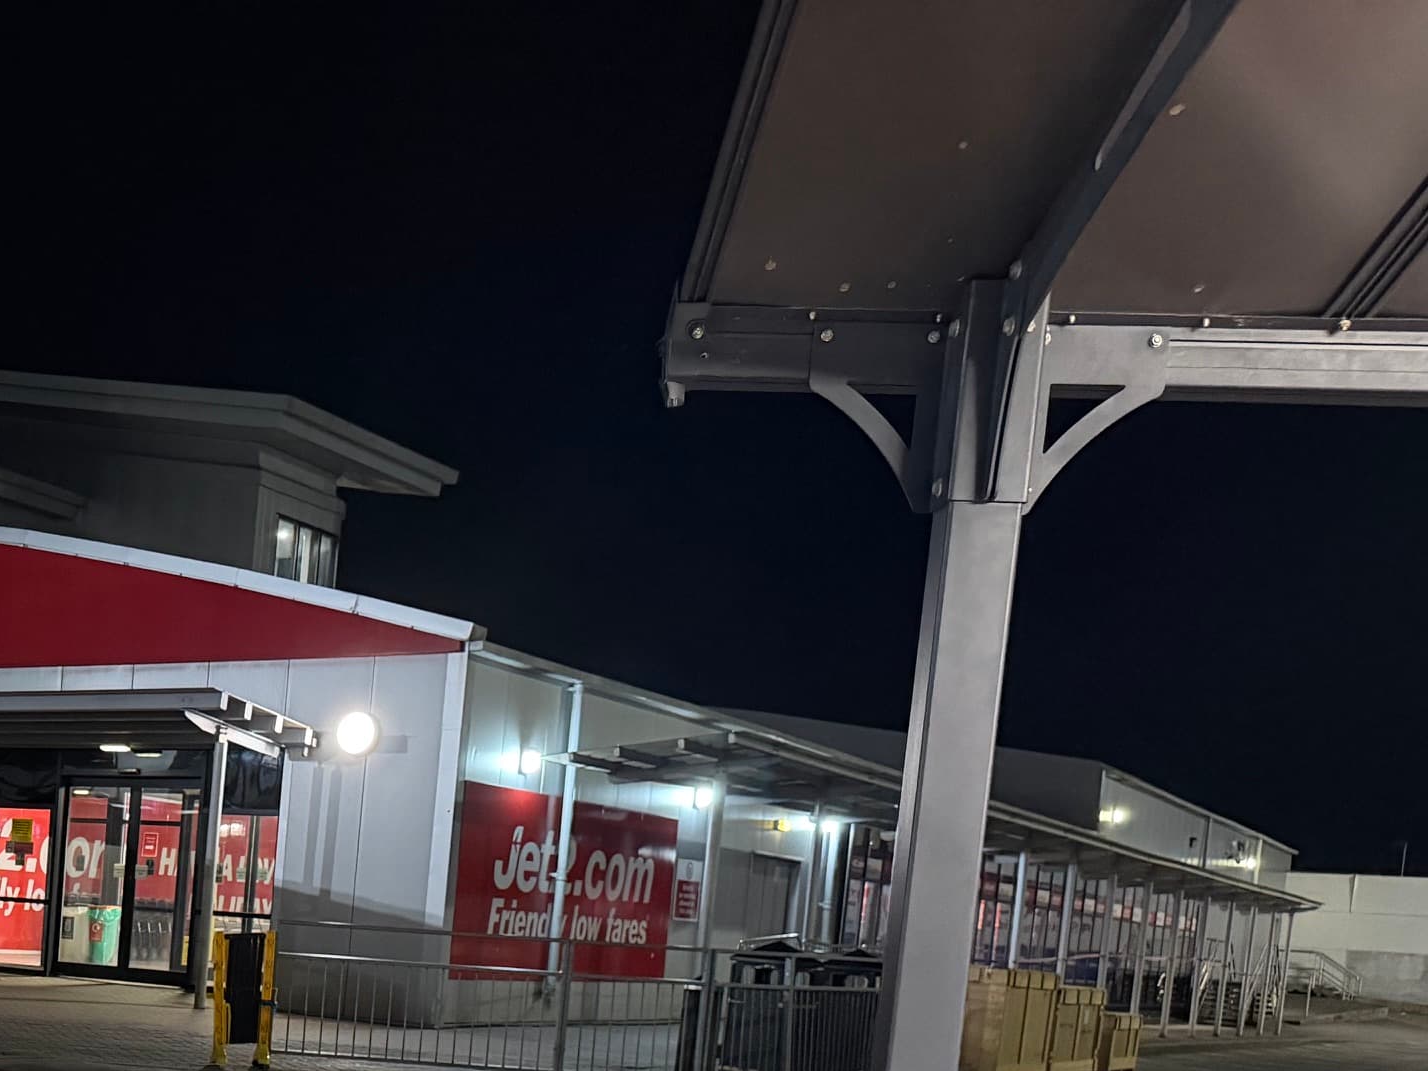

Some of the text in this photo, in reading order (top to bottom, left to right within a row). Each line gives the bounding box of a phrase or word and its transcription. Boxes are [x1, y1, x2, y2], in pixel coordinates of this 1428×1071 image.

[487, 898, 648, 945] Friendy low fares
